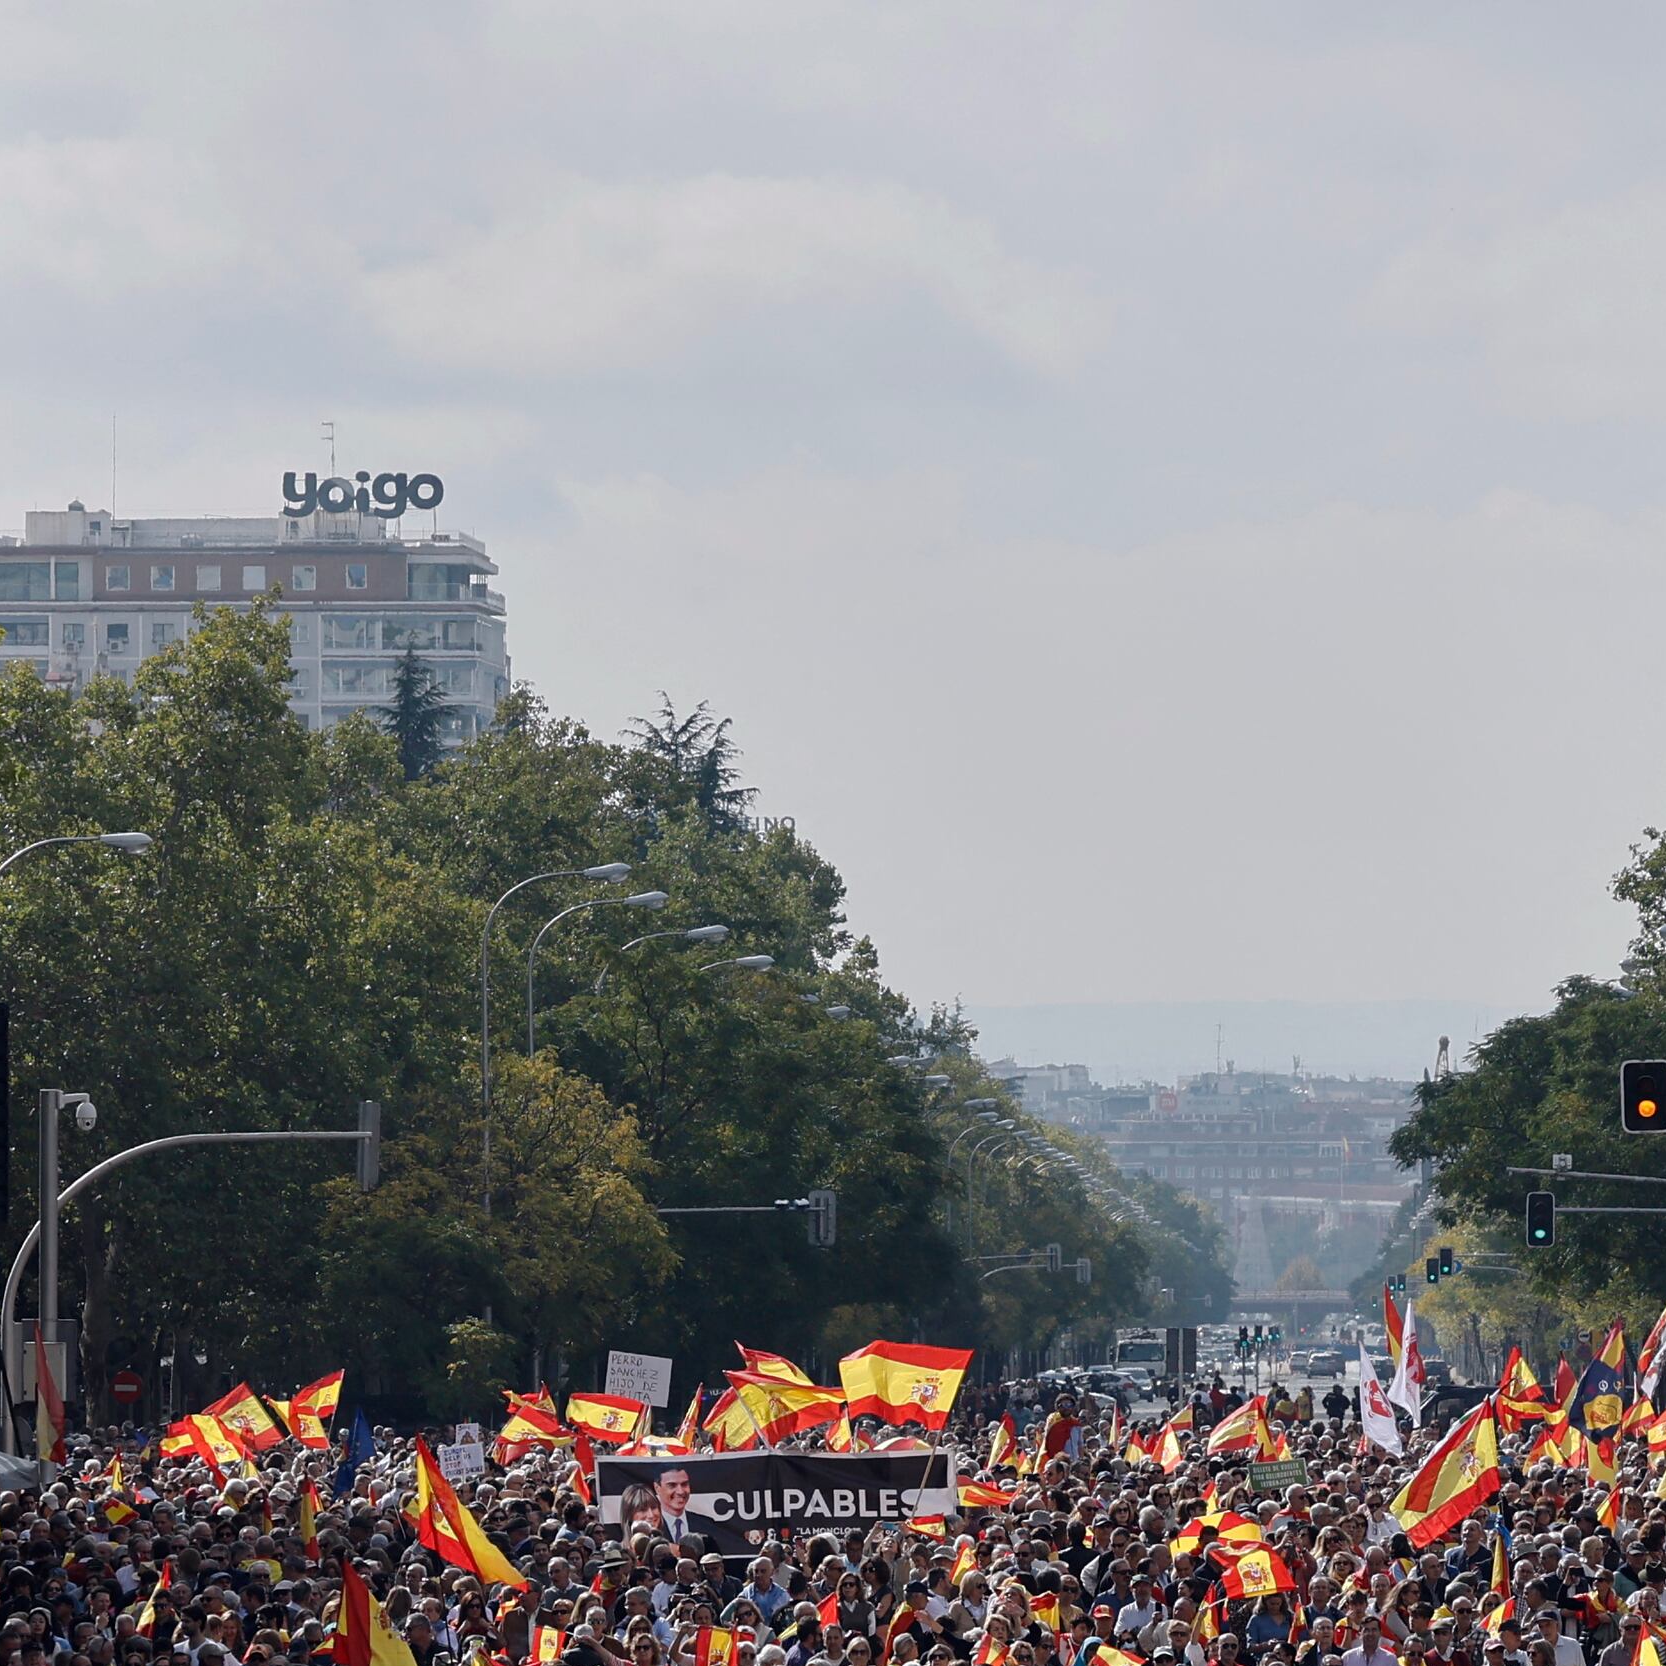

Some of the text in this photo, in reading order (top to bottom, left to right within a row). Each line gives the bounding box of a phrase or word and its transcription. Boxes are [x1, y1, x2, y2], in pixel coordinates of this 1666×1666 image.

[283, 471, 444, 519] yoigo
[611, 1353, 643, 1367] PERRO
[610, 1367, 659, 1380] SANCHEZ
[609, 1378, 658, 1392] HIJO DE
[712, 1488, 917, 1520] CULPABLES
